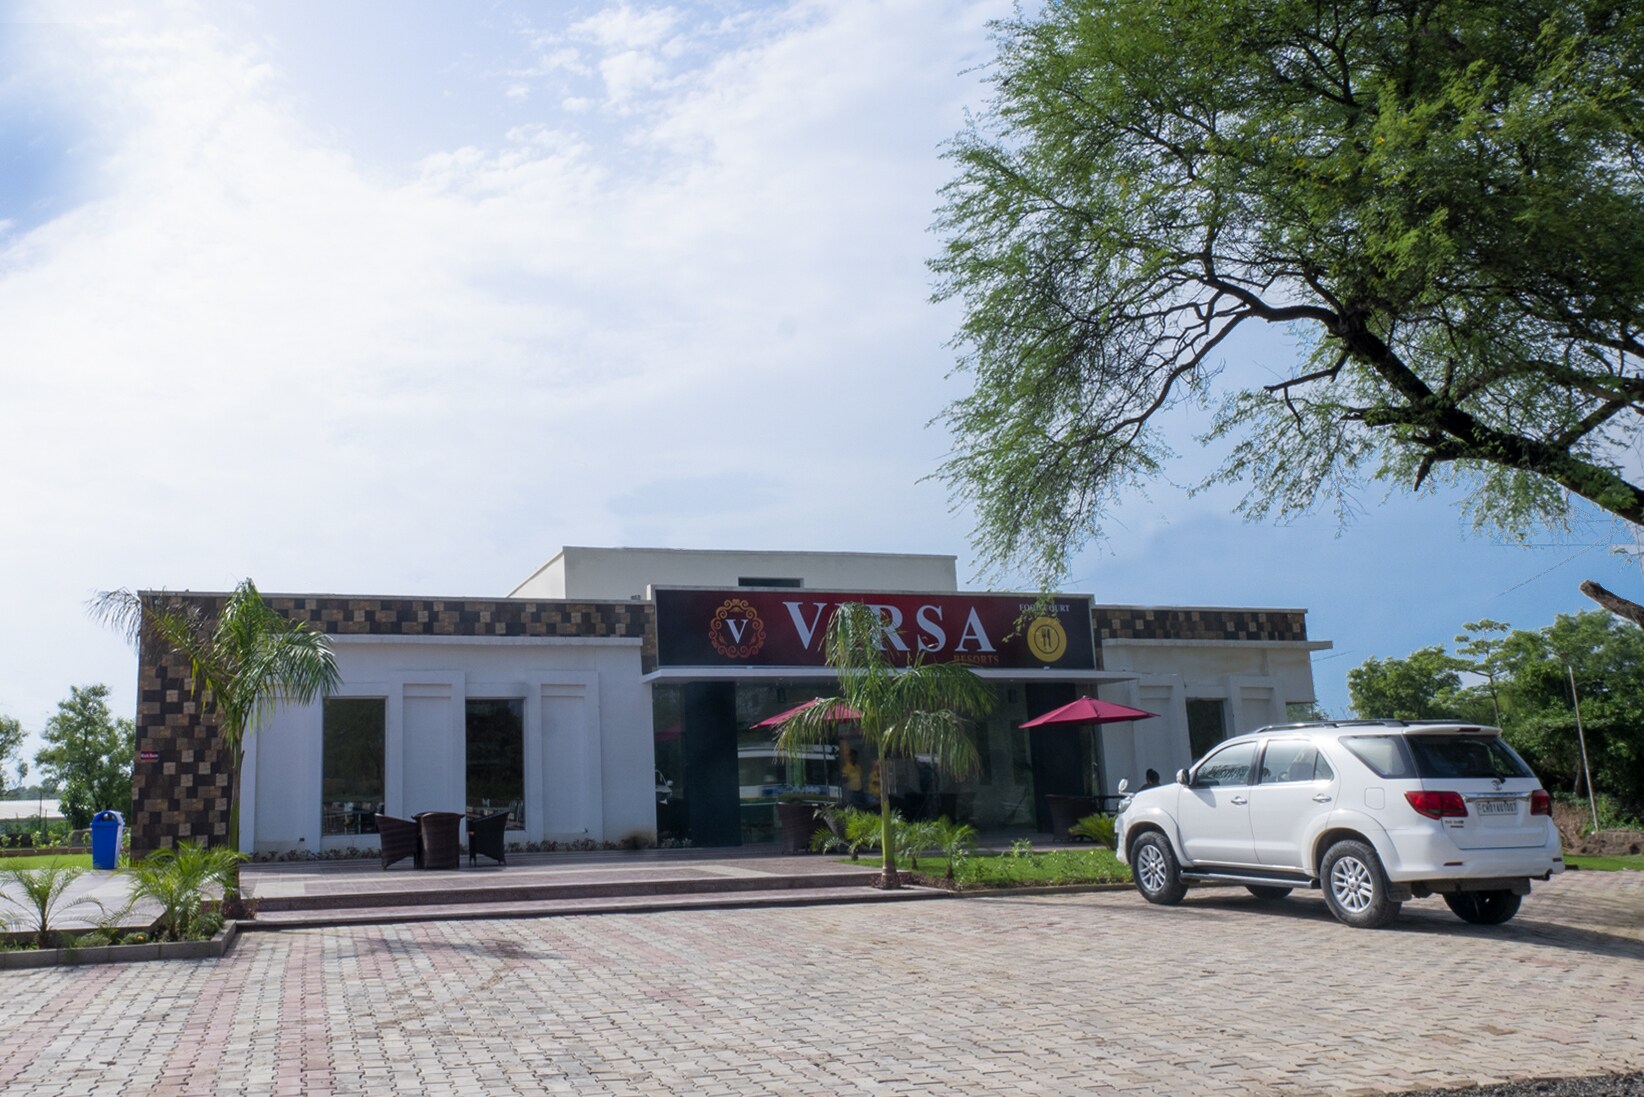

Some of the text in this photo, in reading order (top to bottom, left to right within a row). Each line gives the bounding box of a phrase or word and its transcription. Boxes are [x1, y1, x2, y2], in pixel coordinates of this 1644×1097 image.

[725, 618, 749, 645] V
[782, 601, 997, 653] VRSA
[954, 654, 999, 666] RESORTS
